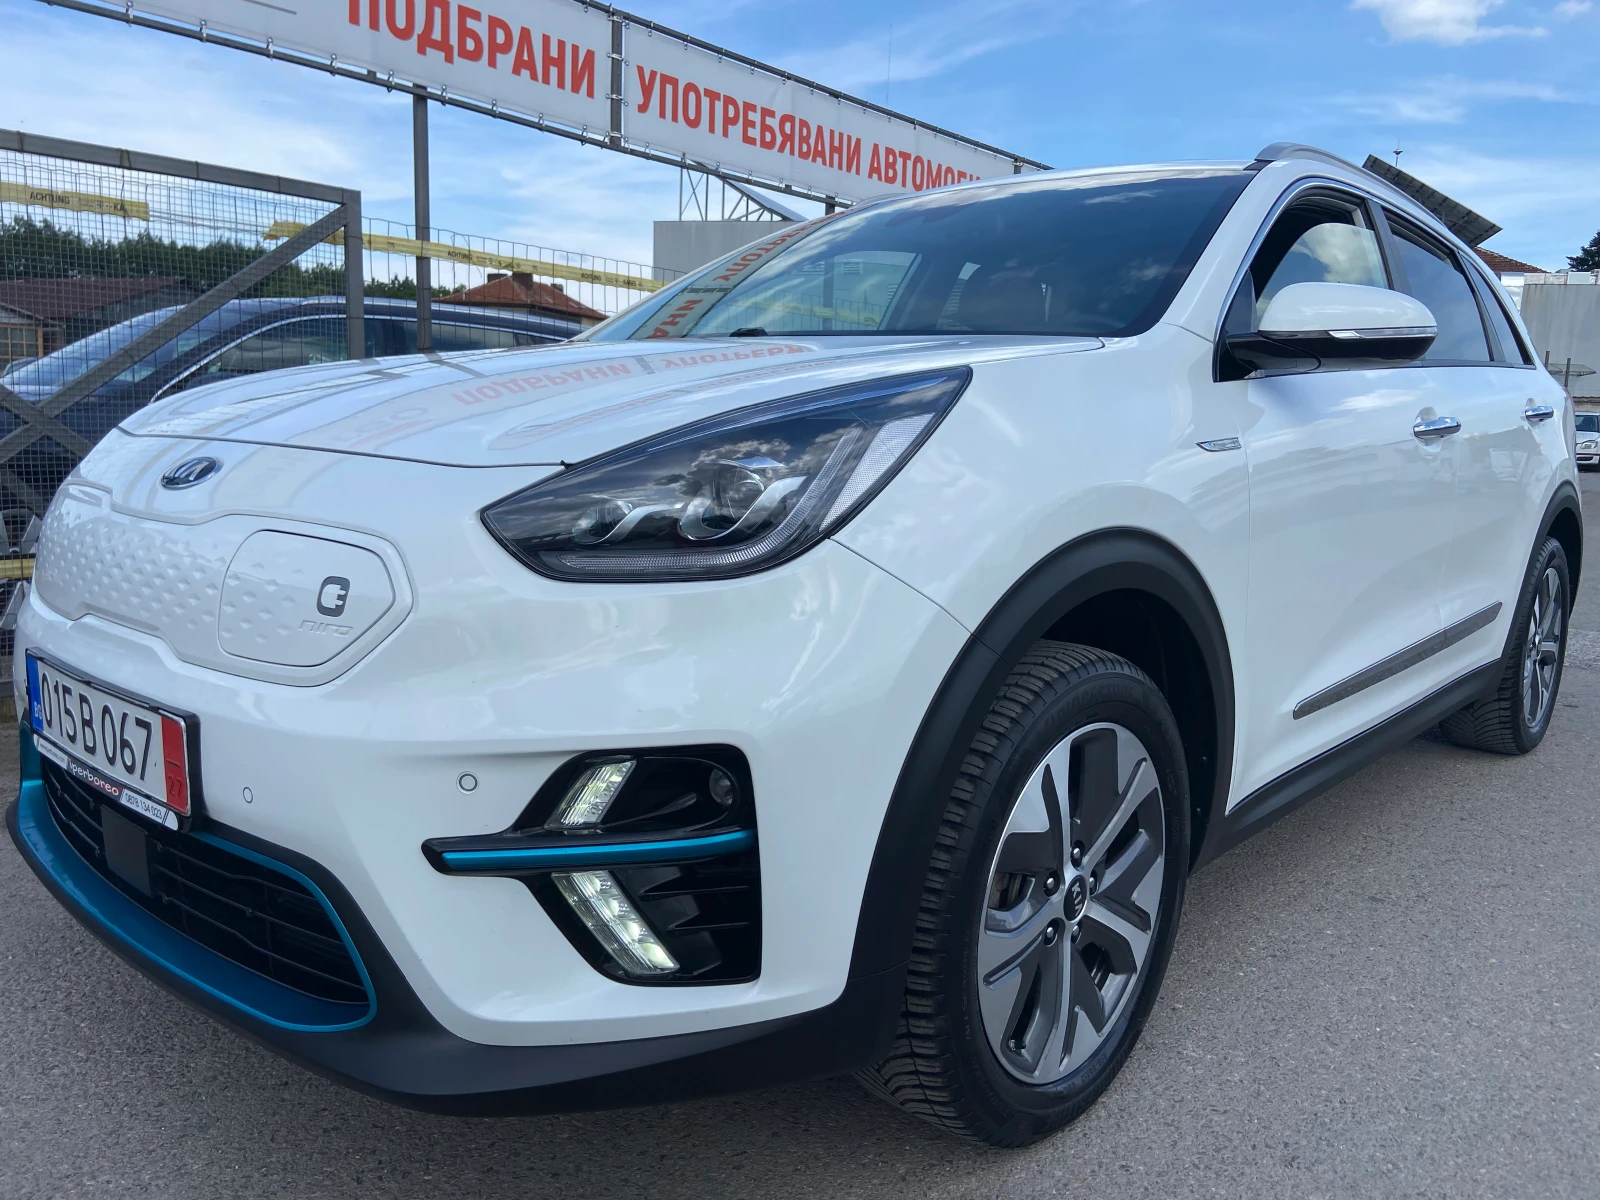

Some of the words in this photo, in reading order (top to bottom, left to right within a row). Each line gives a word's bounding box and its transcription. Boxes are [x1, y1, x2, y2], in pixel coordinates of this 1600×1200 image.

[636, 64, 861, 176] УПОТРЕБЯВАНИ
[867, 143, 980, 192] АВТОМО
[29, 191, 70, 205] ACHTUNG
[447, 250, 473, 261] ACHTUNG
[580, 272, 602, 282] ACHTUNG
[34, 701, 42, 720] BG
[1071, 881, 1083, 916] KIA
